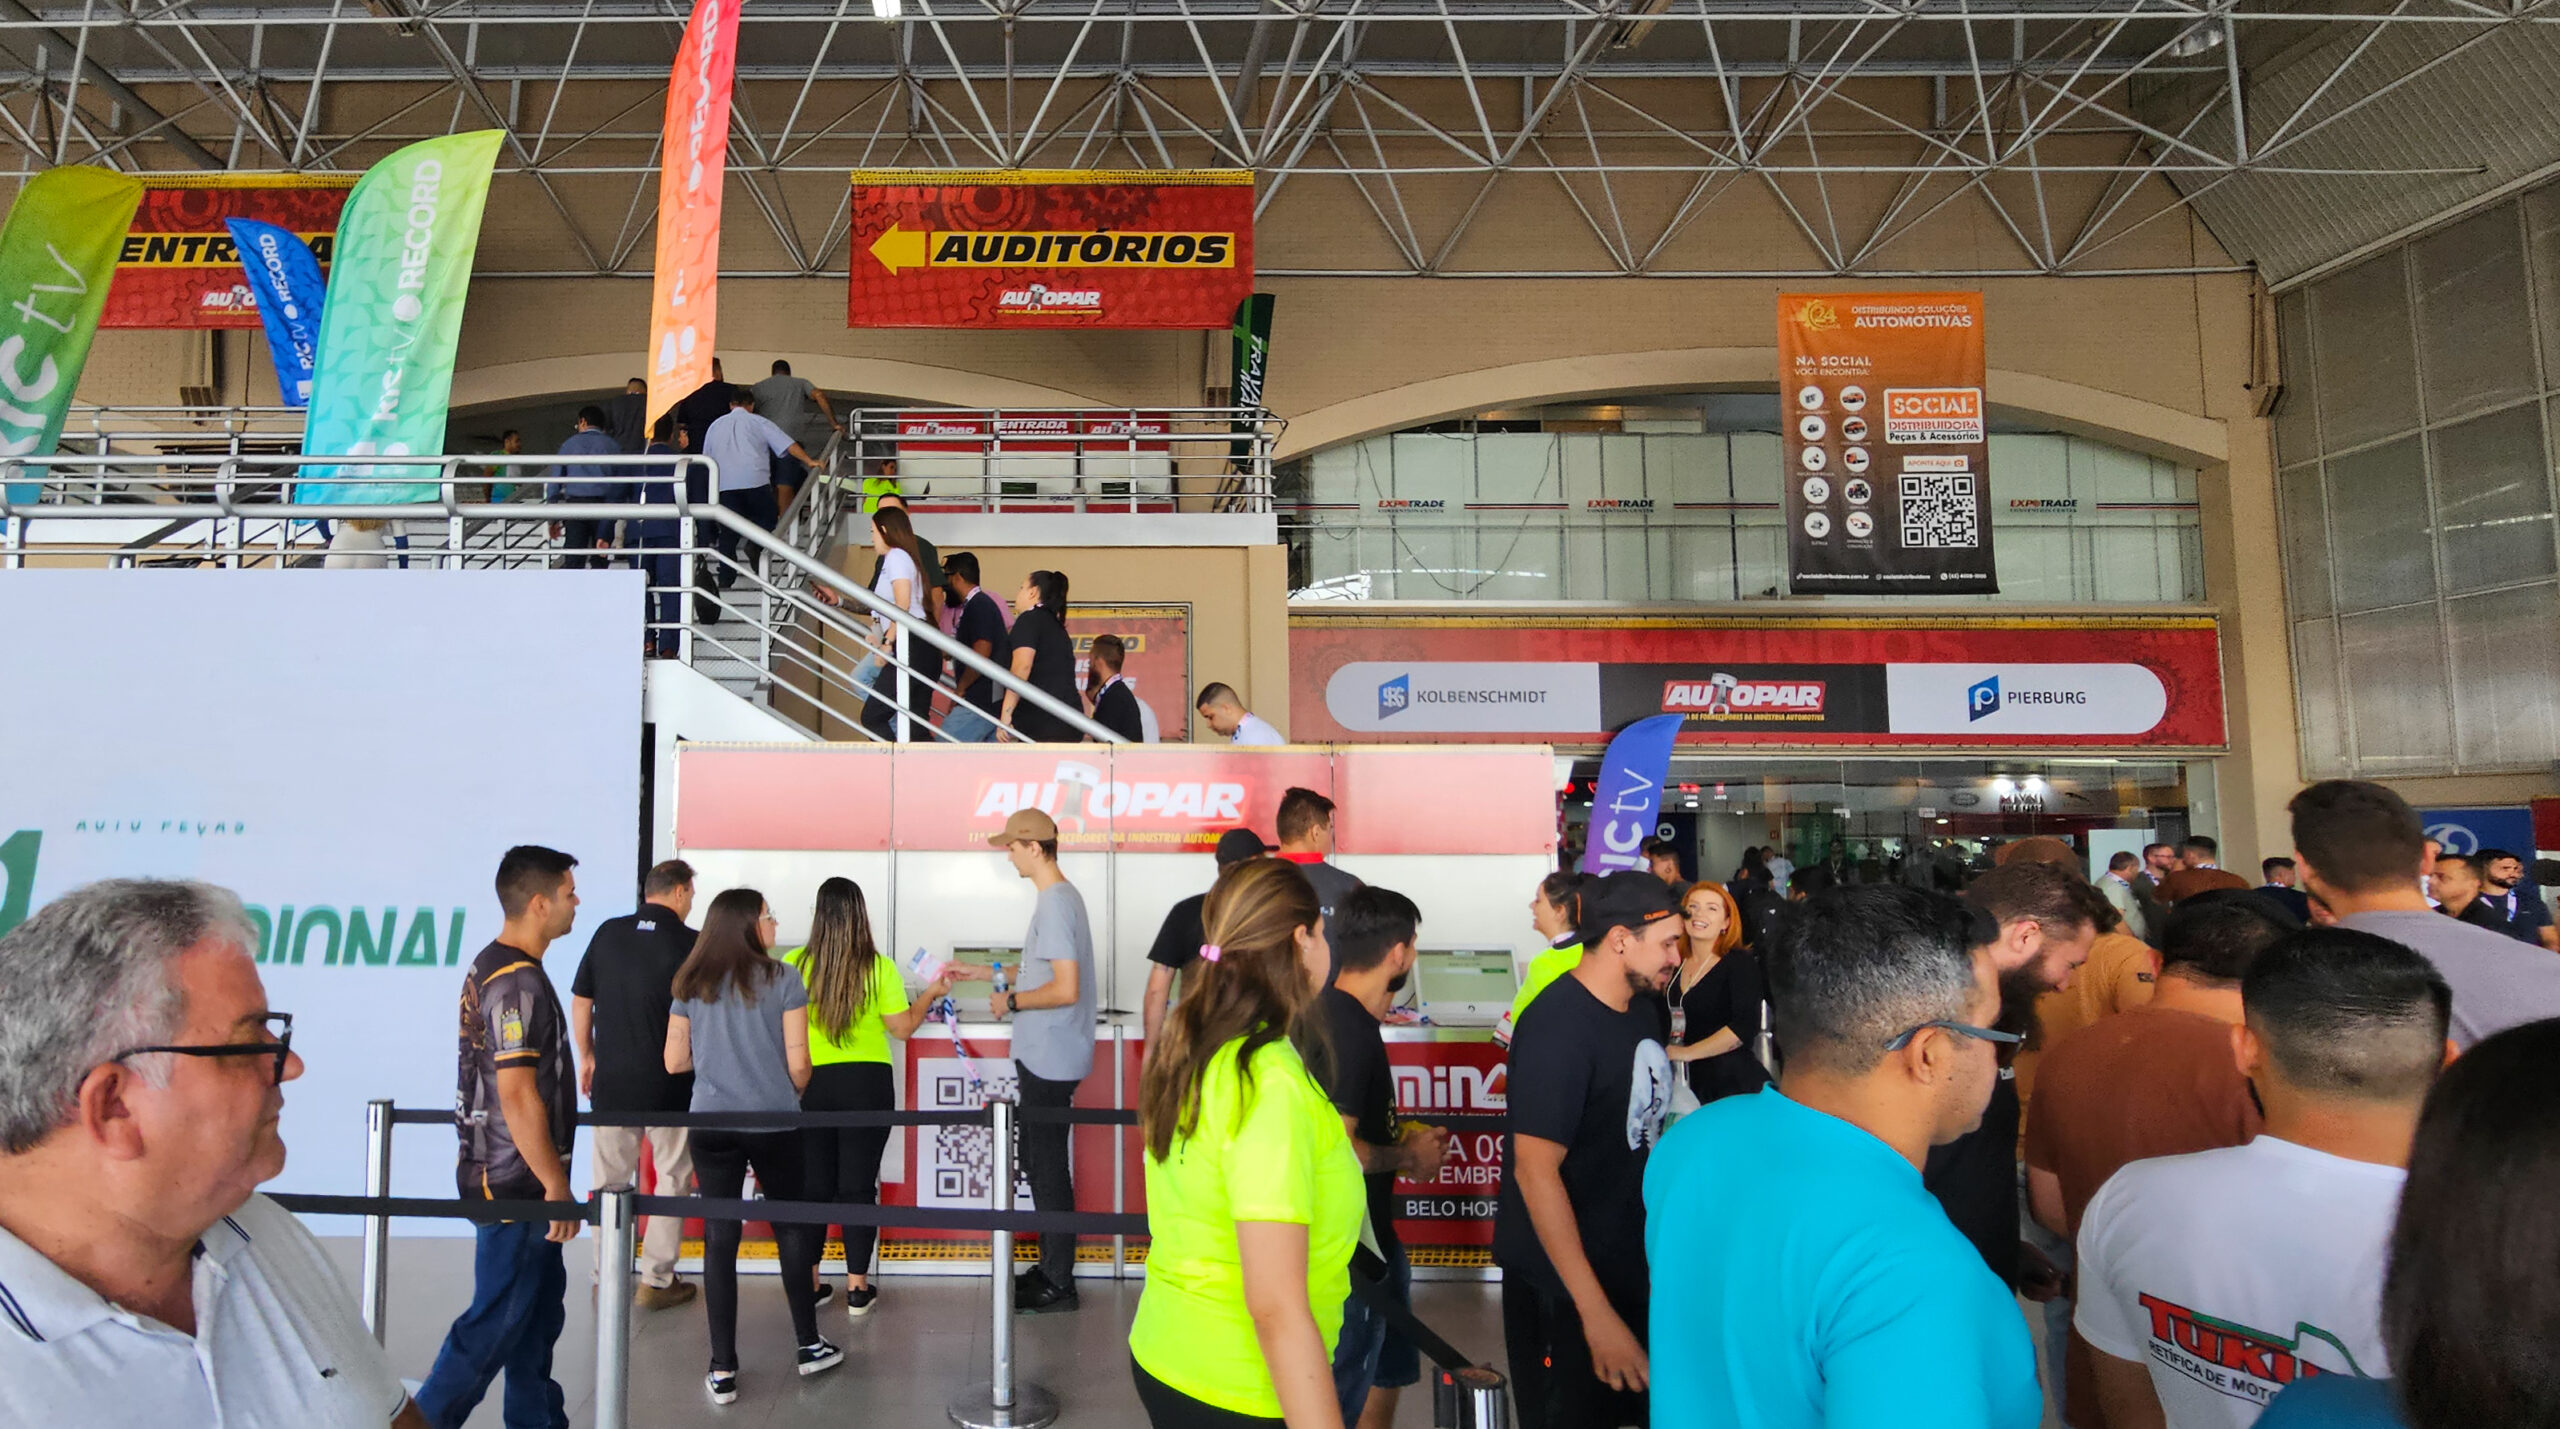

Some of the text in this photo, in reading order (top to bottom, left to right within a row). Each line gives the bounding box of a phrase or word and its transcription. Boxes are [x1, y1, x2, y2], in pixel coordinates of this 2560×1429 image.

[398, 159, 442, 290] RECORD
[118, 236, 334, 263] ENTRA
[934, 227, 1231, 263] AUDITÓRIOS
[259, 233, 293, 302] RECORD
[1000, 284, 1101, 311] AUTOPAR
[1851, 304, 1968, 314] DISTRIBUINDO SOLUÇÕES
[1854, 315, 1973, 328] AUTOMOTIVAS
[1796, 356, 1872, 366] NA SOCIAL
[1894, 398, 1973, 414] SOCIAL
[999, 421, 1068, 430] ENTRADA
[1888, 421, 1979, 430] DISTRIBUIDORA
[1889, 432, 1920, 442] Peças
[1930, 431, 1980, 441] Acessórios
[1378, 500, 1446, 508] EXPOTRADE
[1588, 500, 1655, 508] EXPOTRADE
[2010, 500, 2078, 508] EXPOTRADE
[1417, 691, 1547, 704] KOLBENSCHMIDT
[1665, 674, 1821, 714] AUTOPAR
[2008, 692, 2086, 704] PIERBURG
[1406, 1200, 1456, 1217] BELO
[2205, 1367, 2226, 1388] DE
